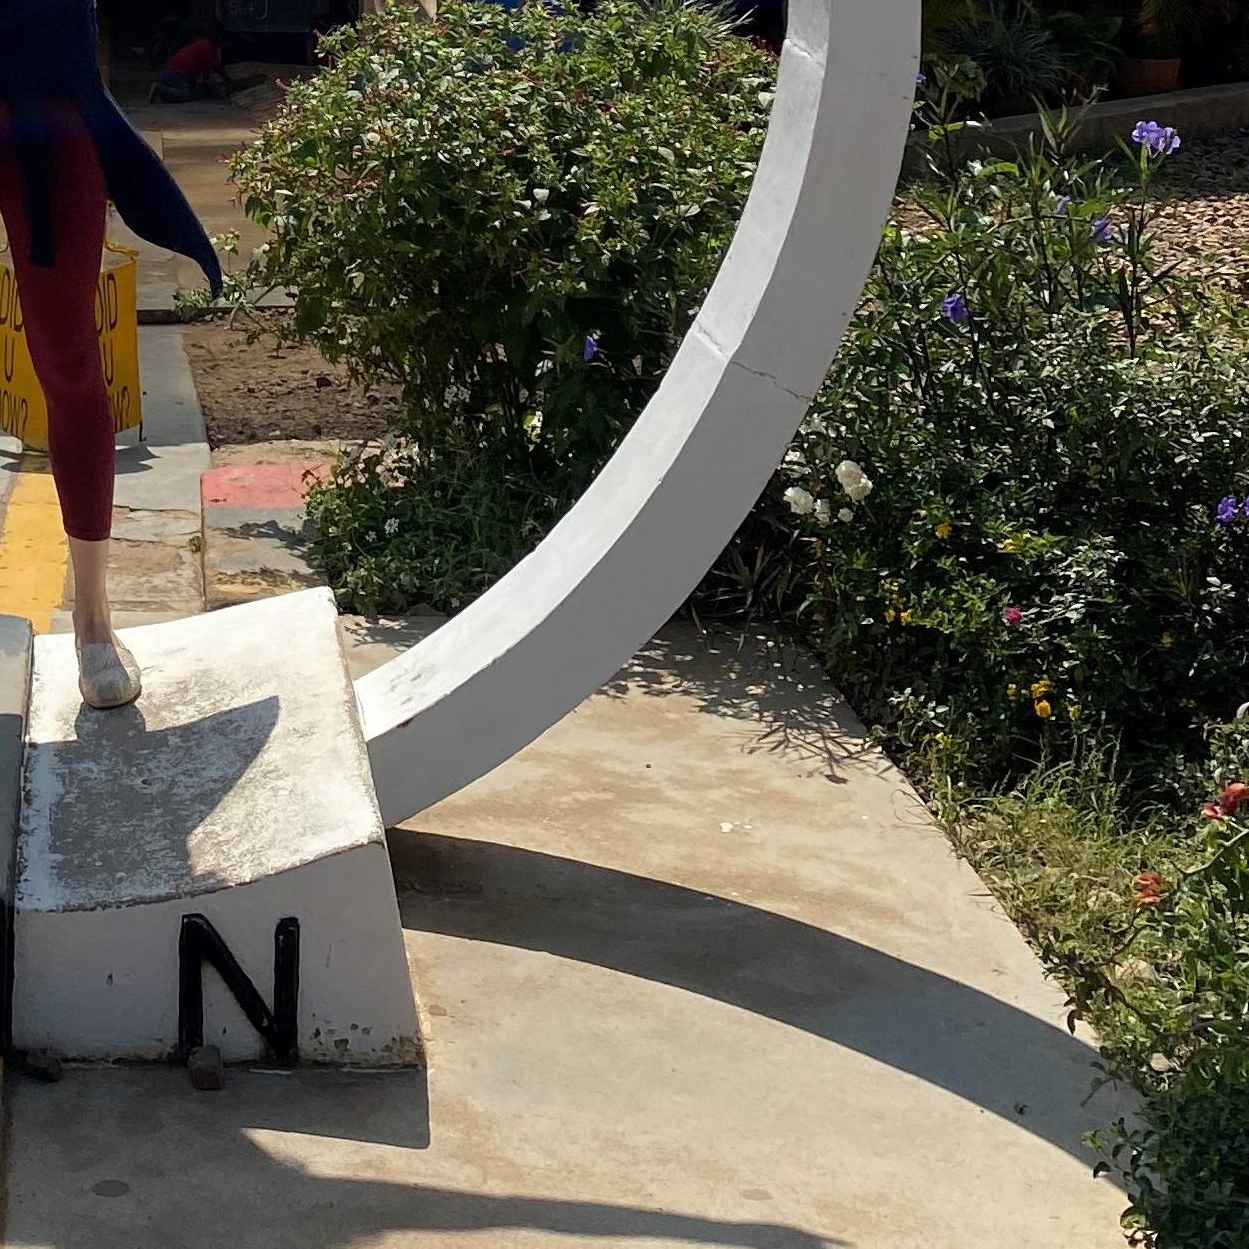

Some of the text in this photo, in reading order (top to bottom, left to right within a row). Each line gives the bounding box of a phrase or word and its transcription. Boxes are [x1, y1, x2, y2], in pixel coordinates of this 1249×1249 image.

[4, 334, 15, 383] U
[103, 337, 114, 386] U
[178, 912, 300, 1065] N
